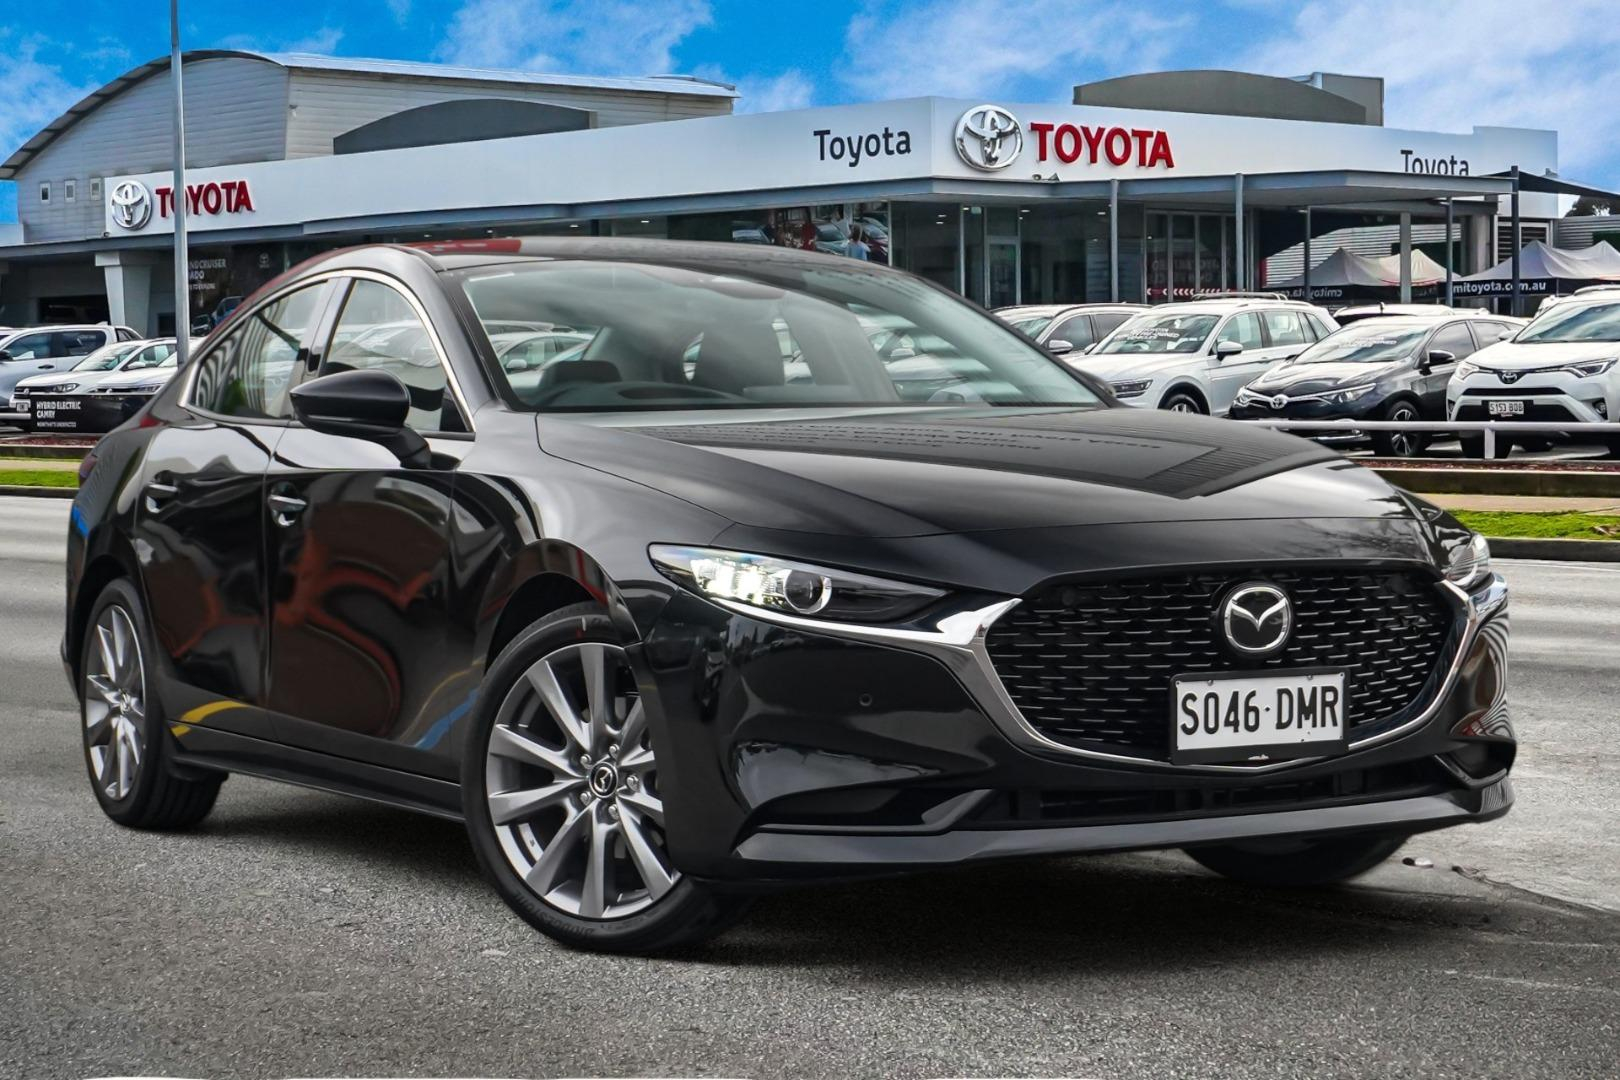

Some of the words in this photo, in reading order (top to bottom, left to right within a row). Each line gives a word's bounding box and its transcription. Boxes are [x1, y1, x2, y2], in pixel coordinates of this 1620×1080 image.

[813, 127, 912, 168] Toyota
[1030, 122, 1175, 169] TOYOTA
[1400, 149, 1469, 176] Toyota
[1452, 281, 1546, 295] mitoyota.cm.au
[37, 401, 56, 410] HYBRID
[57, 401, 81, 410] ELECTRIC
